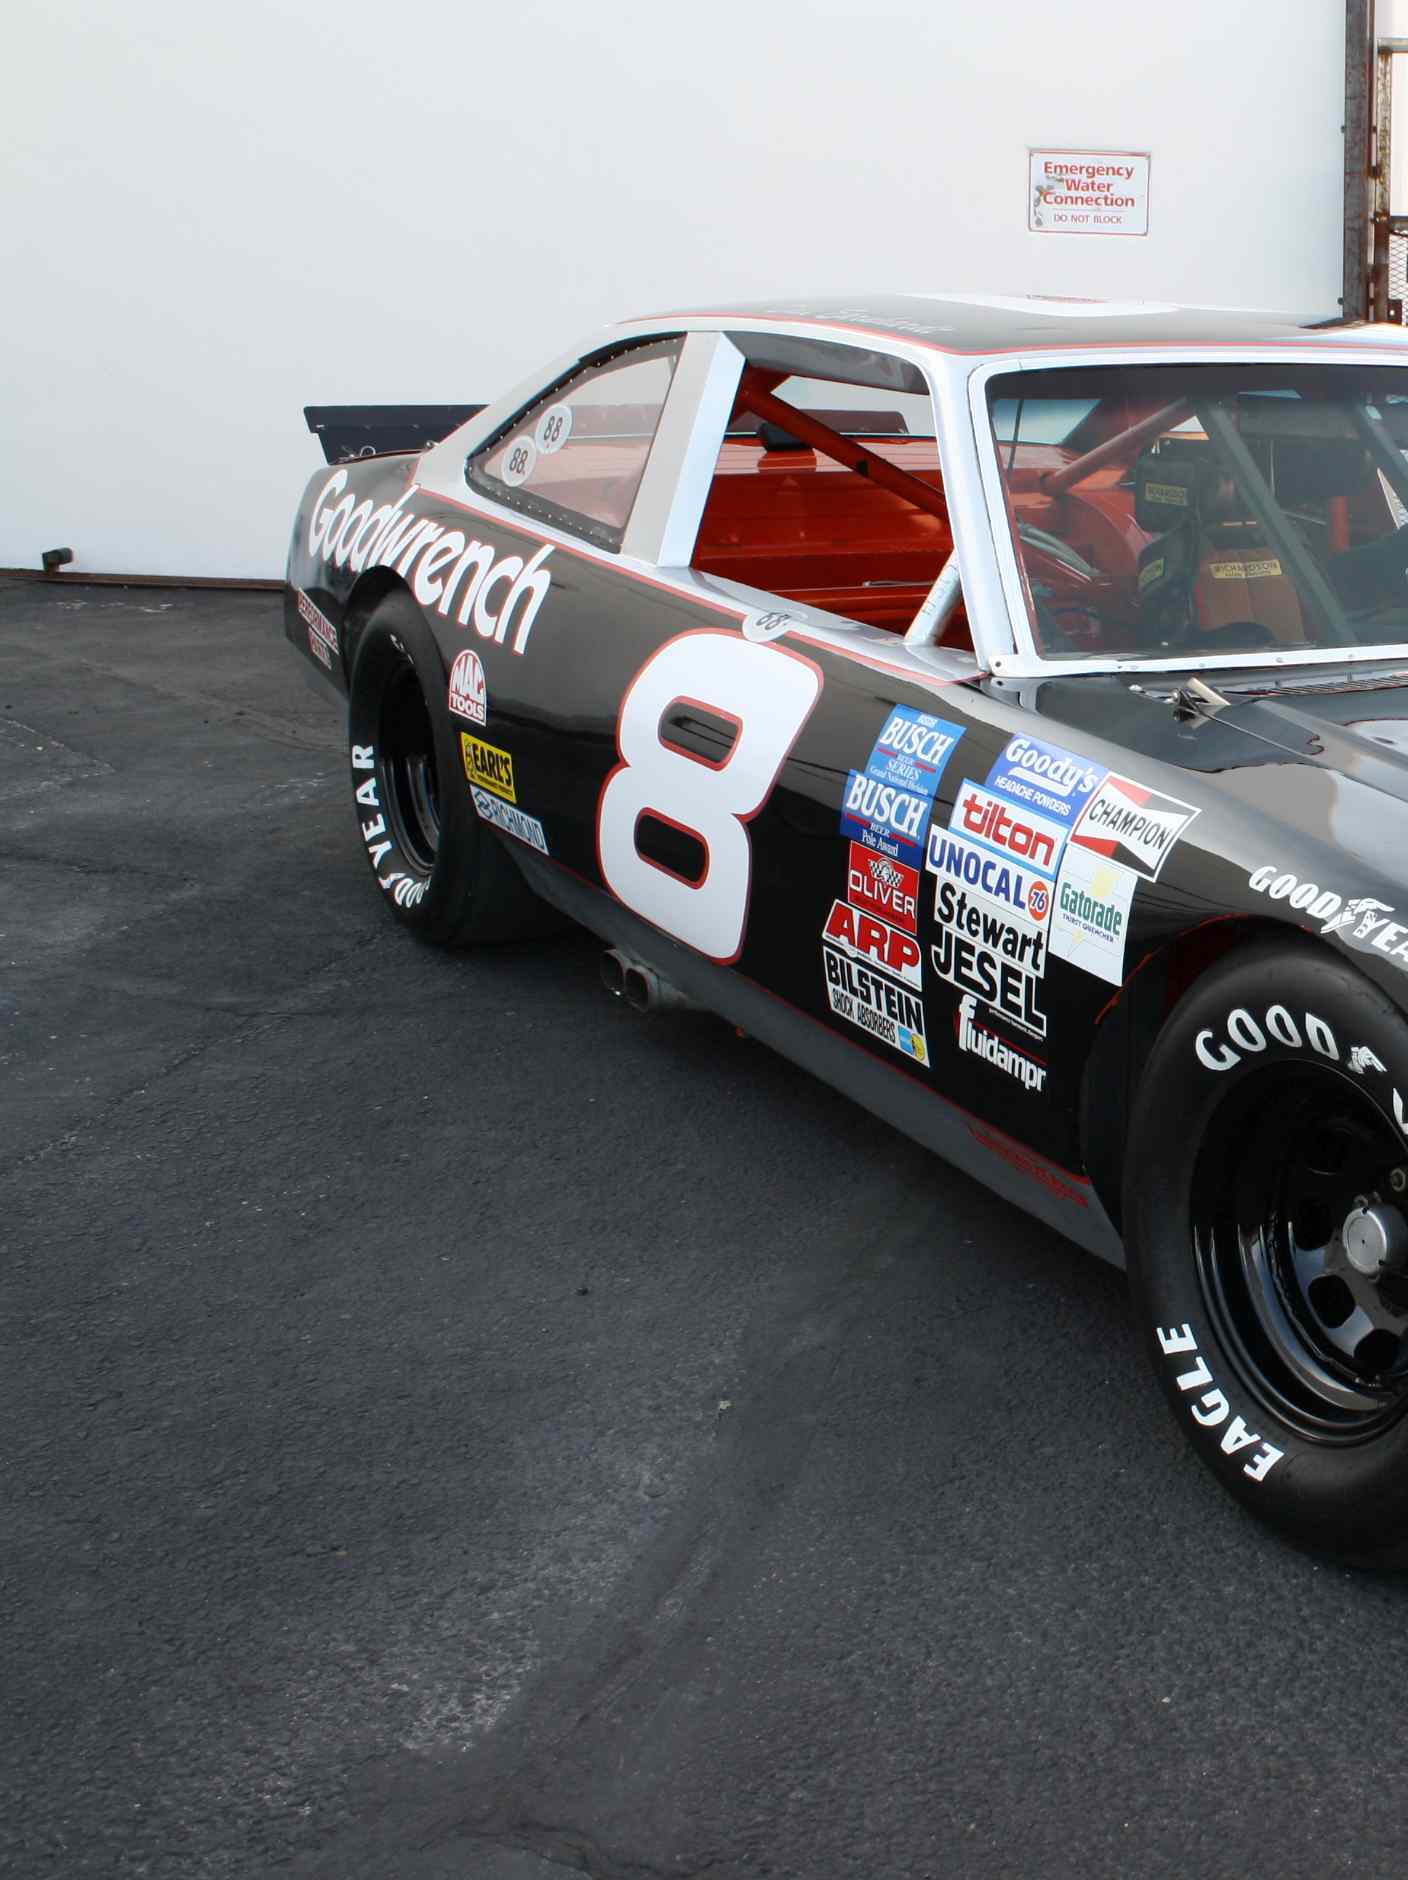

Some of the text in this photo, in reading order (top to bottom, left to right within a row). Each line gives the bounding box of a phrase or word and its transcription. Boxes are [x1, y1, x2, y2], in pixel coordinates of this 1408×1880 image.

[1043, 161, 1135, 180] Emergency
[1065, 178, 1114, 193] Water
[1042, 192, 1136, 208] Connection
[1053, 213, 1122, 225] DO NOT BLOCK
[308, 469, 556, 656] Goodwrench
[451, 653, 485, 706] MAC
[451, 692, 485, 721] TOOLS
[471, 742, 512, 787] EARL'S
[879, 716, 955, 765] BUSCH
[1005, 738, 1100, 794] Goody's
[596, 627, 825, 967] 8
[846, 774, 929, 839] BUSCH
[994, 776, 1073, 817] HEADACHE POWDERS
[1088, 798, 1171, 851] CHAMPION
[962, 793, 1056, 867] tilton
[848, 869, 916, 920] OLIVER
[928, 834, 1046, 911] UNOCAL 76
[824, 900, 921, 974] ARP
[936, 881, 1045, 974] Stewart
[1060, 881, 1123, 937] Gatorade
[824, 948, 925, 1037] BILSTEIN
[931, 927, 1047, 1037] JESEL
[831, 986, 897, 1044] SHOCK ABSORBERS
[1155, 1321, 1285, 1483] EAGLE
